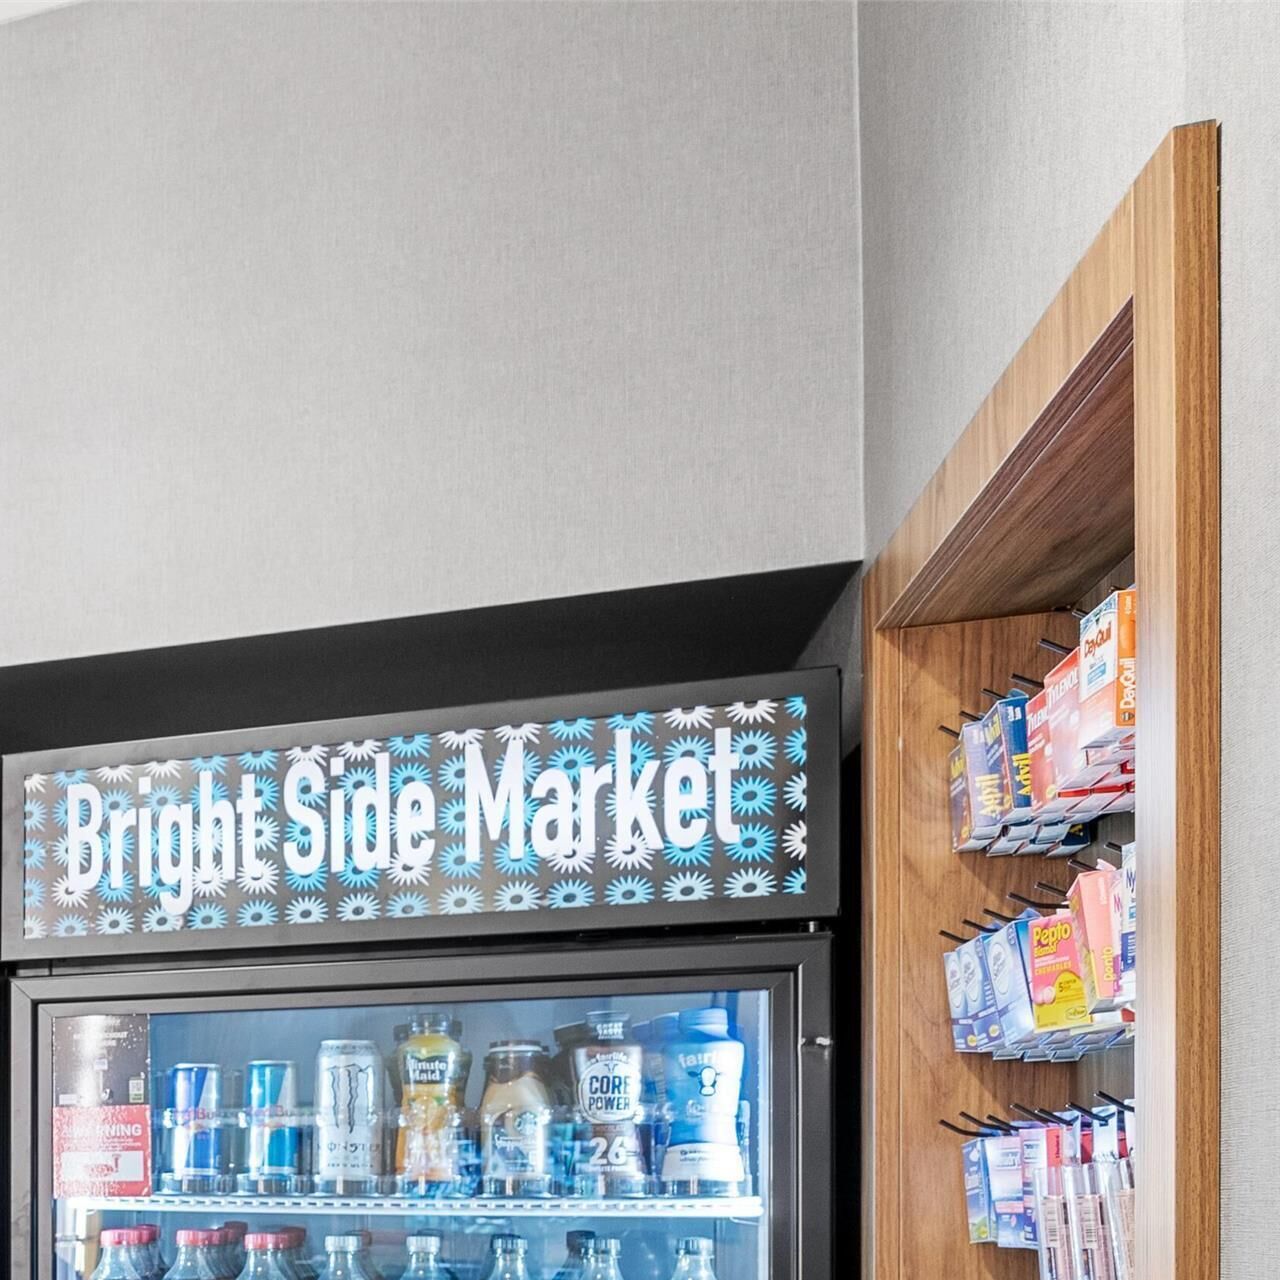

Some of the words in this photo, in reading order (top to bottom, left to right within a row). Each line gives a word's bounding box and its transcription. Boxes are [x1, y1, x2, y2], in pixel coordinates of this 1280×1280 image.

[1027, 707, 1048, 734] TYLEN
[66, 771, 264, 917] Bright
[284, 753, 436, 875] Side
[465, 727, 741, 863] Market
[1032, 921, 1072, 946] Pepto
[589, 1074, 631, 1095] CORE
[588, 1095, 631, 1112] POWER
[592, 1136, 630, 1165] 26
